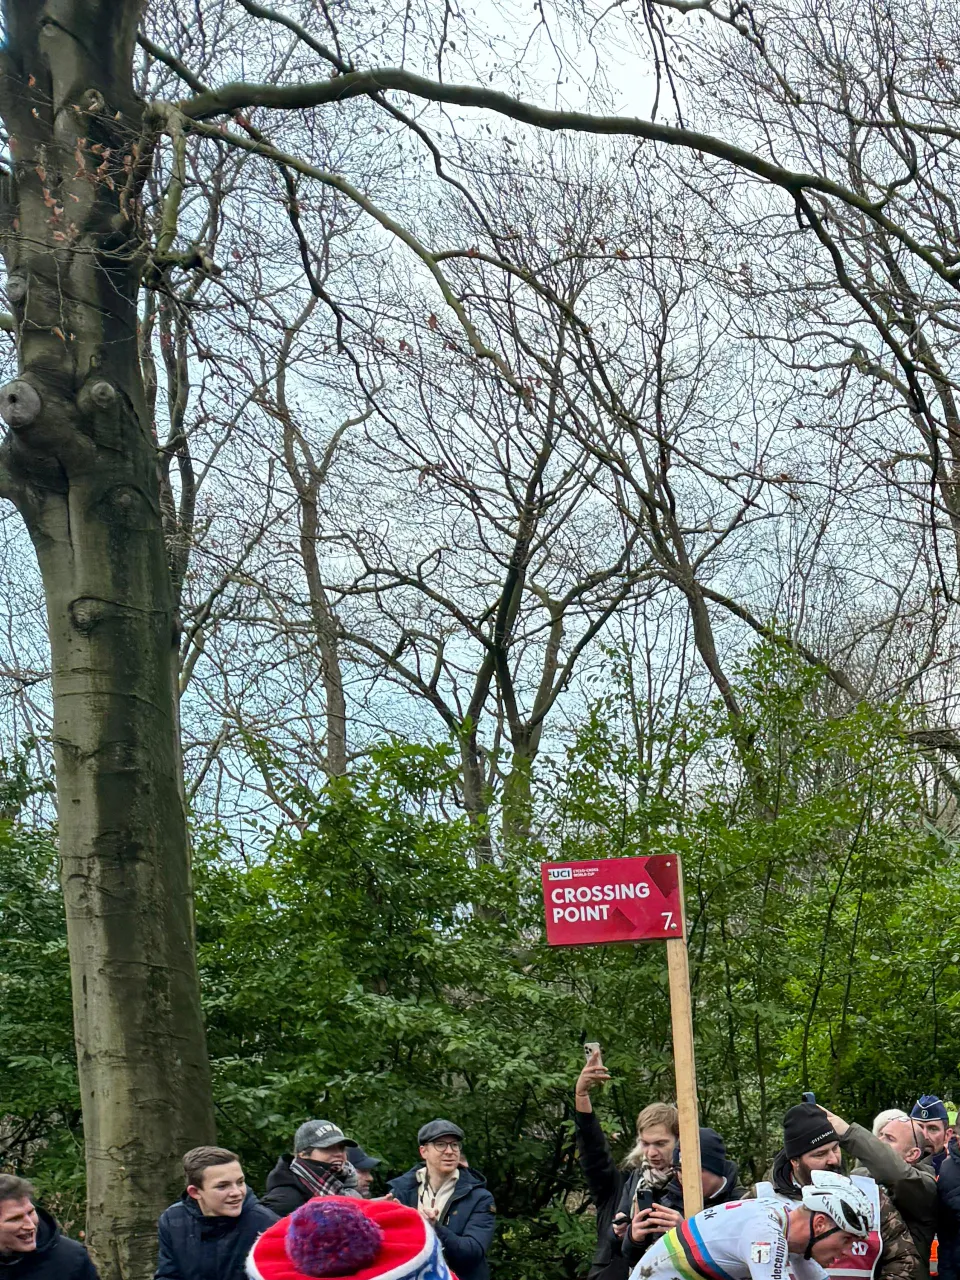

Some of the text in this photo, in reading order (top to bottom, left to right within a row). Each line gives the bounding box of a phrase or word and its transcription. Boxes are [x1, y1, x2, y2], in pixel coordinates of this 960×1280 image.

[552, 869, 571, 879] UCI
[551, 882, 650, 904] CROSSING
[552, 904, 610, 924] POINT
[822, 1195, 846, 1230] CANYON
